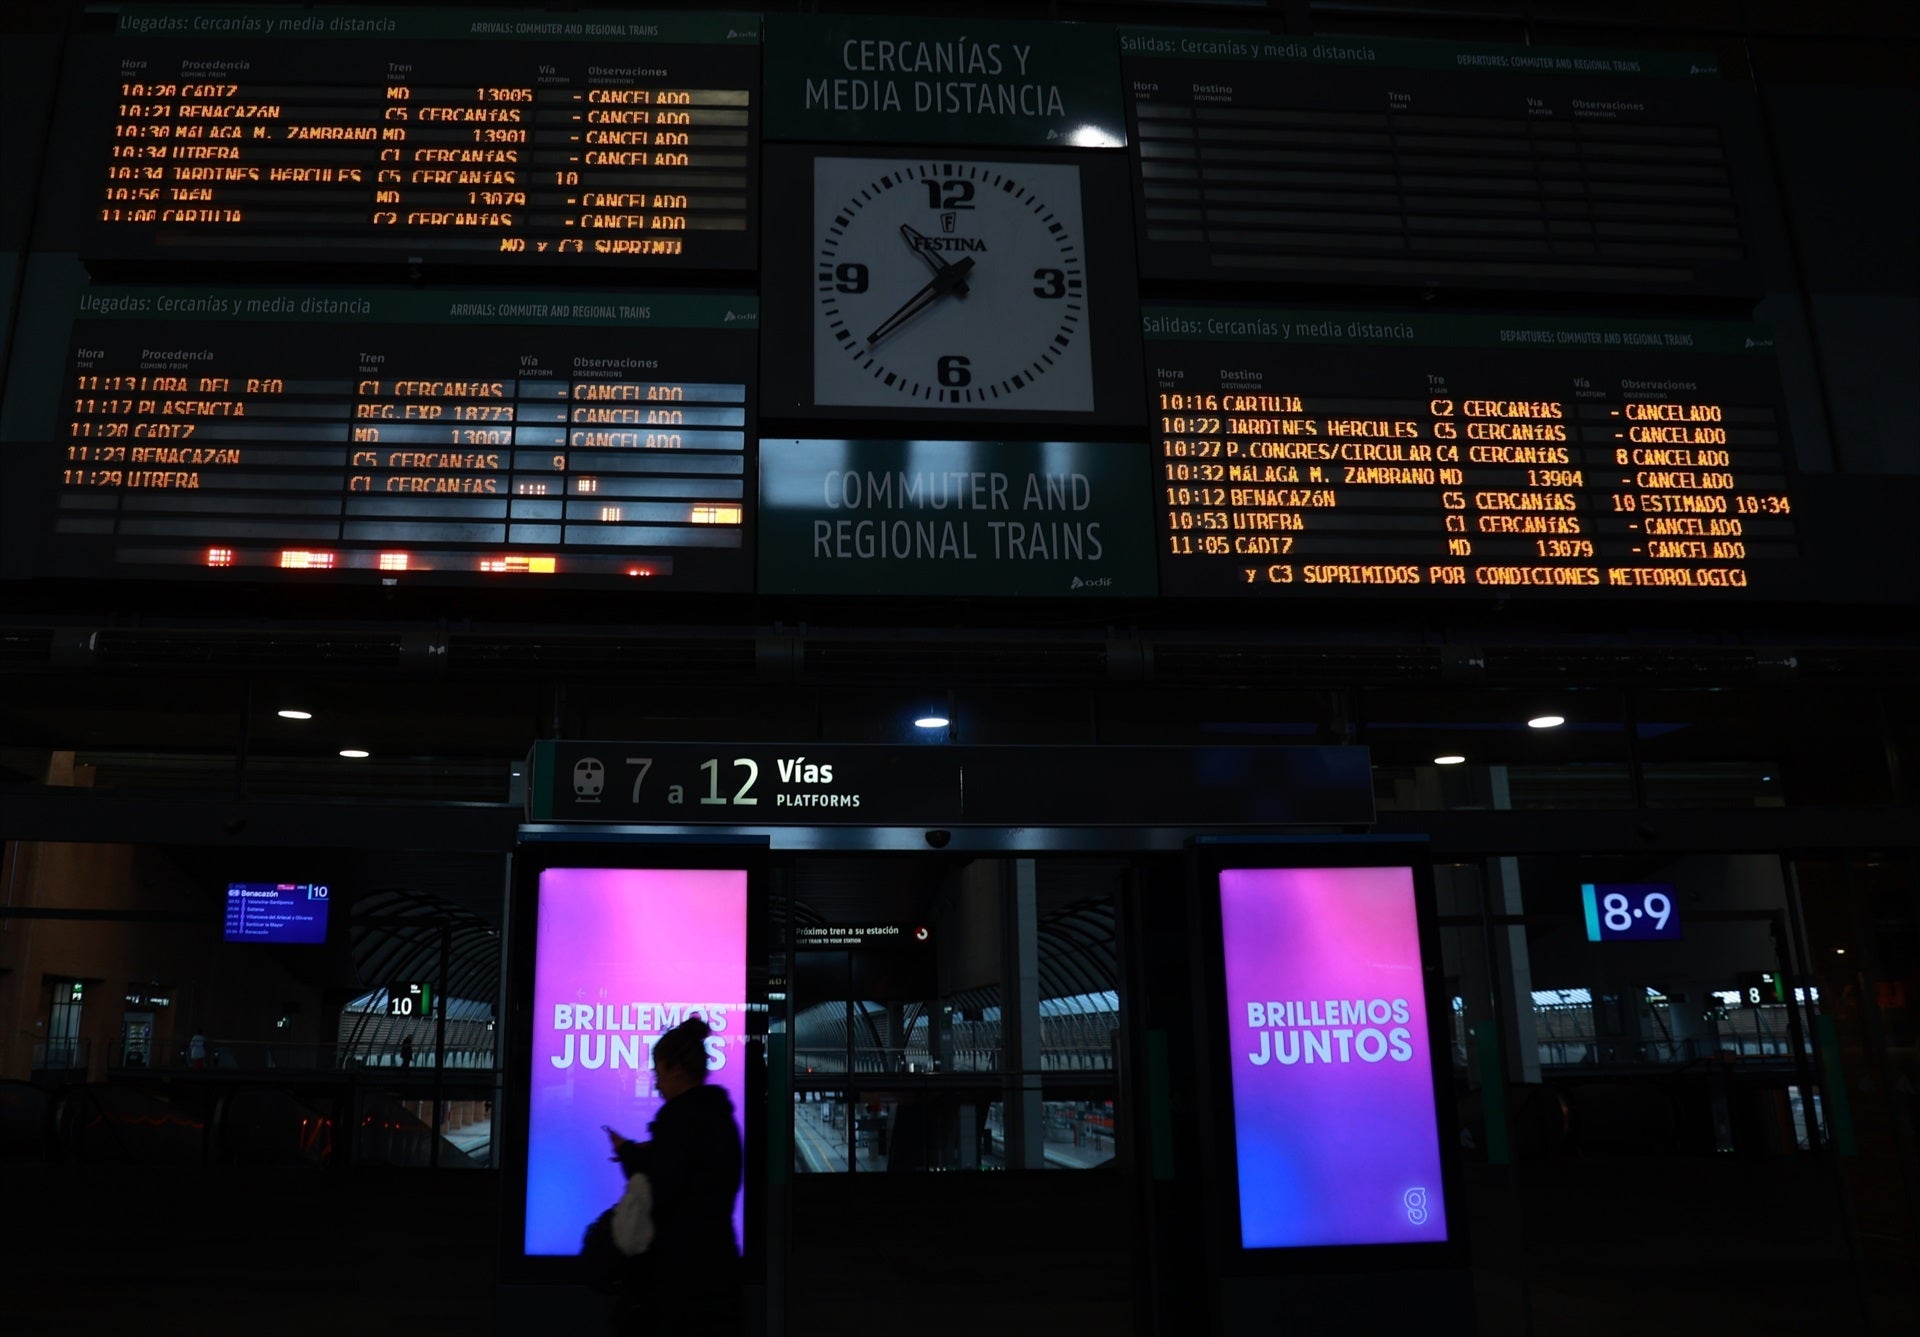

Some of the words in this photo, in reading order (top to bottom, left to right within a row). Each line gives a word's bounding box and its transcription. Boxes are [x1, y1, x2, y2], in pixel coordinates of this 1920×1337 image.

[121, 16, 188, 32] Llegadas:
[194, 16, 261, 30] Cercanías
[266, 20, 274, 33] y
[280, 17, 324, 30] media
[330, 17, 395, 31] distancia
[471, 23, 512, 33] ARRIVALS:
[516, 23, 562, 34] COMMUTER
[564, 24, 582, 34] AND
[585, 24, 626, 35] REGIONAL
[629, 25, 658, 35] TRAINS
[844, 36, 1002, 74] CERCANÍAS
[1013, 45, 1030, 75] Y
[1121, 36, 1175, 51] Salidas:
[1182, 39, 1247, 54] Cercanías
[1251, 45, 1258, 58] y
[1264, 44, 1307, 57] media
[1313, 45, 1375, 60] distancia
[122, 60, 147, 68] Hora
[183, 60, 249, 69] Procedencia
[389, 63, 411, 71] Tren
[1457, 55, 1509, 66] DEPARTURES:
[1511, 57, 1553, 68] COMMUTER
[1556, 59, 1571, 69] AND
[1574, 59, 1611, 70] REGIONAL
[1613, 61, 1640, 71] TRAINS
[589, 67, 667, 76] Observaciones
[1134, 82, 1158, 90] Hora
[1193, 84, 1232, 93] Destino
[478, 89, 532, 101] 13005
[806, 79, 901, 111] MEDIA
[915, 82, 1065, 116] DISTANCIA
[1572, 100, 1644, 110] Observaciones
[558, 172, 577, 184] 10
[921, 179, 975, 209] 12
[914, 237, 986, 252] FESTINA
[836, 263, 868, 294] 9
[1033, 269, 1065, 299] 3
[81, 295, 151, 313] Llegadas:
[157, 295, 228, 311] Cercanías
[233, 300, 242, 315] y
[247, 297, 294, 312] media
[301, 298, 370, 313] distancia
[451, 304, 495, 316] ARRIVALS:
[499, 304, 548, 316] COMMUTER
[551, 305, 569, 317] AND
[573, 306, 616, 318] REGIONAL
[620, 307, 650, 318] TRAINS
[1144, 317, 1201, 333] Salidas:
[1208, 319, 1277, 335] Cercanías
[1282, 324, 1290, 339] y
[1296, 322, 1341, 336] media
[1348, 322, 1413, 338] distancia
[1500, 330, 1554, 342] DEPARTURES:
[1557, 332, 1601, 343] COMMUTER
[1604, 333, 1621, 344] AND
[1623, 333, 1663, 345] REGIONAL
[1664, 334, 1693, 346] TRAINS
[78, 349, 104, 358] Hora
[142, 350, 213, 360] Procedencia
[360, 353, 384, 363] Tren
[521, 355, 538, 365] Vía
[574, 357, 658, 368] Observaciones
[938, 356, 971, 387] 6
[1158, 368, 1183, 378] Hora
[1221, 370, 1262, 380] Destino
[1574, 378, 1590, 387] Vía
[1622, 379, 1696, 390] Observaciones
[1161, 395, 1217, 410] 10:16
[1223, 396, 1302, 412] CARTUJA
[1431, 400, 1453, 416] C2
[1626, 405, 1721, 421] CANCELADO
[1163, 418, 1219, 433] 10:22
[1434, 423, 1456, 438] C5
[1630, 427, 1725, 444] CANCELADO
[1165, 441, 1220, 456] 10:27
[1227, 442, 1431, 461] P.CONGRES/CIRCULAR
[1437, 446, 1458, 461] C4
[1617, 449, 1628, 464] 8
[1633, 449, 1729, 466] CANCELADO
[1166, 465, 1223, 480] 10:32
[1310, 467, 1328, 482] M.
[1344, 467, 1434, 484] ZAMBRANO
[1440, 469, 1462, 484] MD
[1528, 470, 1582, 486] 13904
[1637, 472, 1733, 488] CANCELADO
[824, 471, 1009, 511] COMMUTER
[1023, 473, 1090, 512] AND
[1167, 488, 1224, 505] 10:12
[1443, 492, 1465, 509] C5
[1613, 495, 1635, 511] 10
[1641, 495, 1727, 512] ESTIMADO
[1736, 497, 1790, 513] 10:34
[1169, 512, 1228, 529] 10:53
[1446, 516, 1465, 531] C1
[1645, 518, 1742, 536] CANCELADO
[814, 520, 976, 558] REGIONAL
[988, 522, 1102, 560] TRAINS
[1171, 536, 1229, 553] 11:05
[1449, 539, 1471, 555] MD
[1537, 540, 1593, 556] 13079
[1648, 541, 1745, 558] CANCELADO
[1085, 578, 1112, 586] adif
[1246, 570, 1256, 582] y
[1269, 565, 1292, 582] C3
[1304, 566, 1419, 583] SUPRIMIDOS
[1430, 567, 1465, 584] POR
[1476, 567, 1599, 585] CONDICIONES
[776, 756, 833, 784] Vías
[626, 758, 652, 804] 7
[667, 784, 684, 804] a
[700, 758, 759, 806] 12
[776, 794, 860, 807] PLATFORMS
[314, 886, 328, 897] 10
[796, 926, 828, 935] Próximo
[866, 926, 899, 935] estación
[1749, 987, 1760, 1004] 8
[391, 998, 412, 1015] 10
[1247, 999, 1410, 1027] BRILLEMOS
[554, 1003, 727, 1032] BRILLEMOS
[551, 1034, 727, 1070] JUNTS
[1249, 1028, 1412, 1065] JUNTOS
